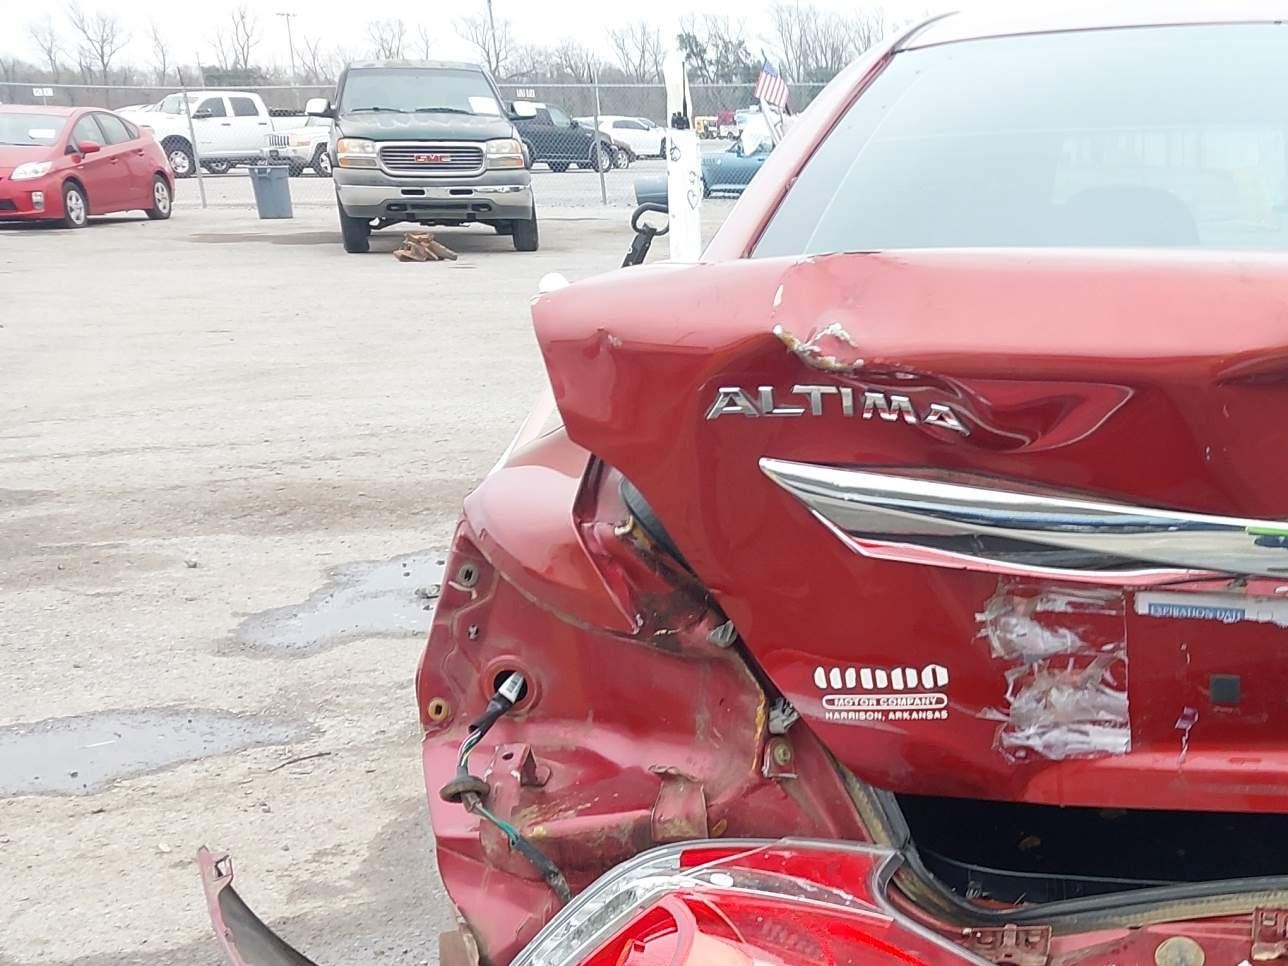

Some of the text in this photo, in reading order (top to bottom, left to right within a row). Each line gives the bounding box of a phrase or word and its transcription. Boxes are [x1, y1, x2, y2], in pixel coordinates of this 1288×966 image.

[414, 153, 450, 163] GMC
[704, 384, 971, 437] ALTIMA
[834, 696, 938, 707] MOTOR COMPANY
[825, 709, 949, 721] HARRISON, ARKANSAS
